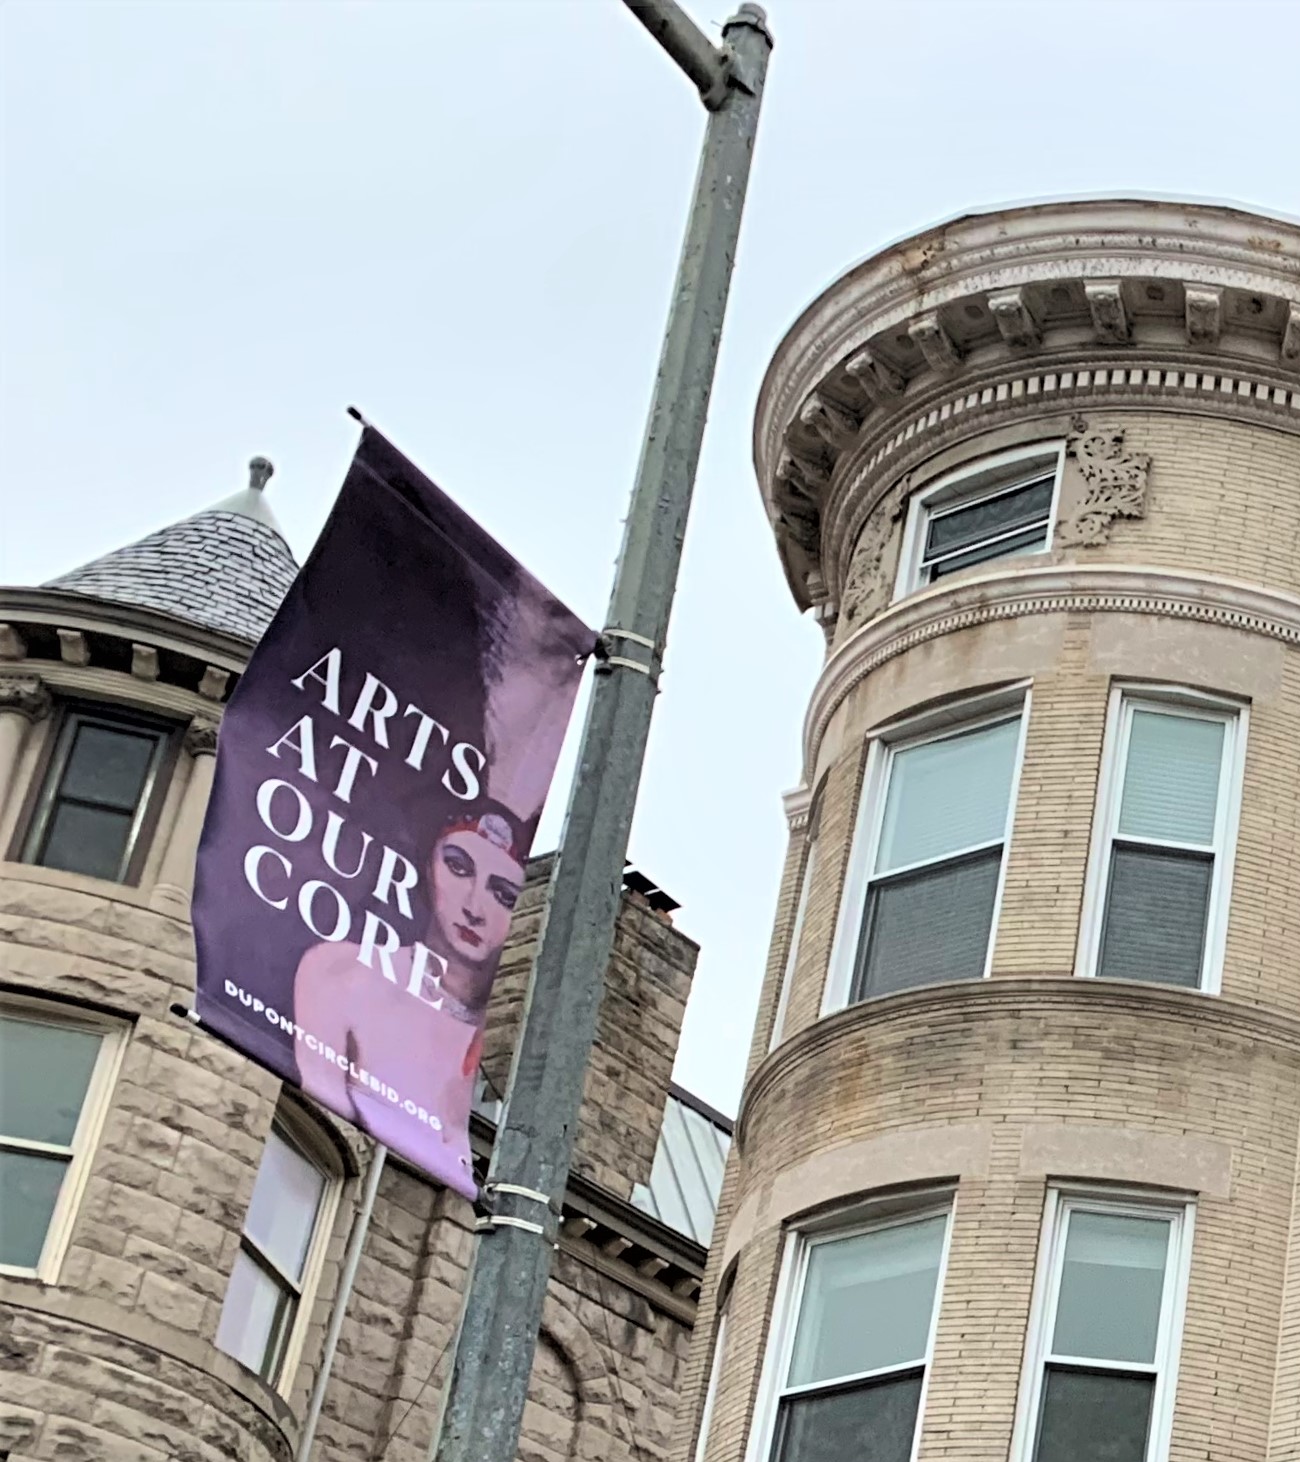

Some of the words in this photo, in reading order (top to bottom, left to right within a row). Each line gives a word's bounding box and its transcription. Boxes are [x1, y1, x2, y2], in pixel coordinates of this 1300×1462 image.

[266, 714, 379, 804] AT
[291, 646, 486, 801] ARTS
[256, 778, 420, 920] OUR
[243, 844, 449, 1011] CORE
[224, 979, 443, 1131] DUPONTCIRCLEBID.ORG
